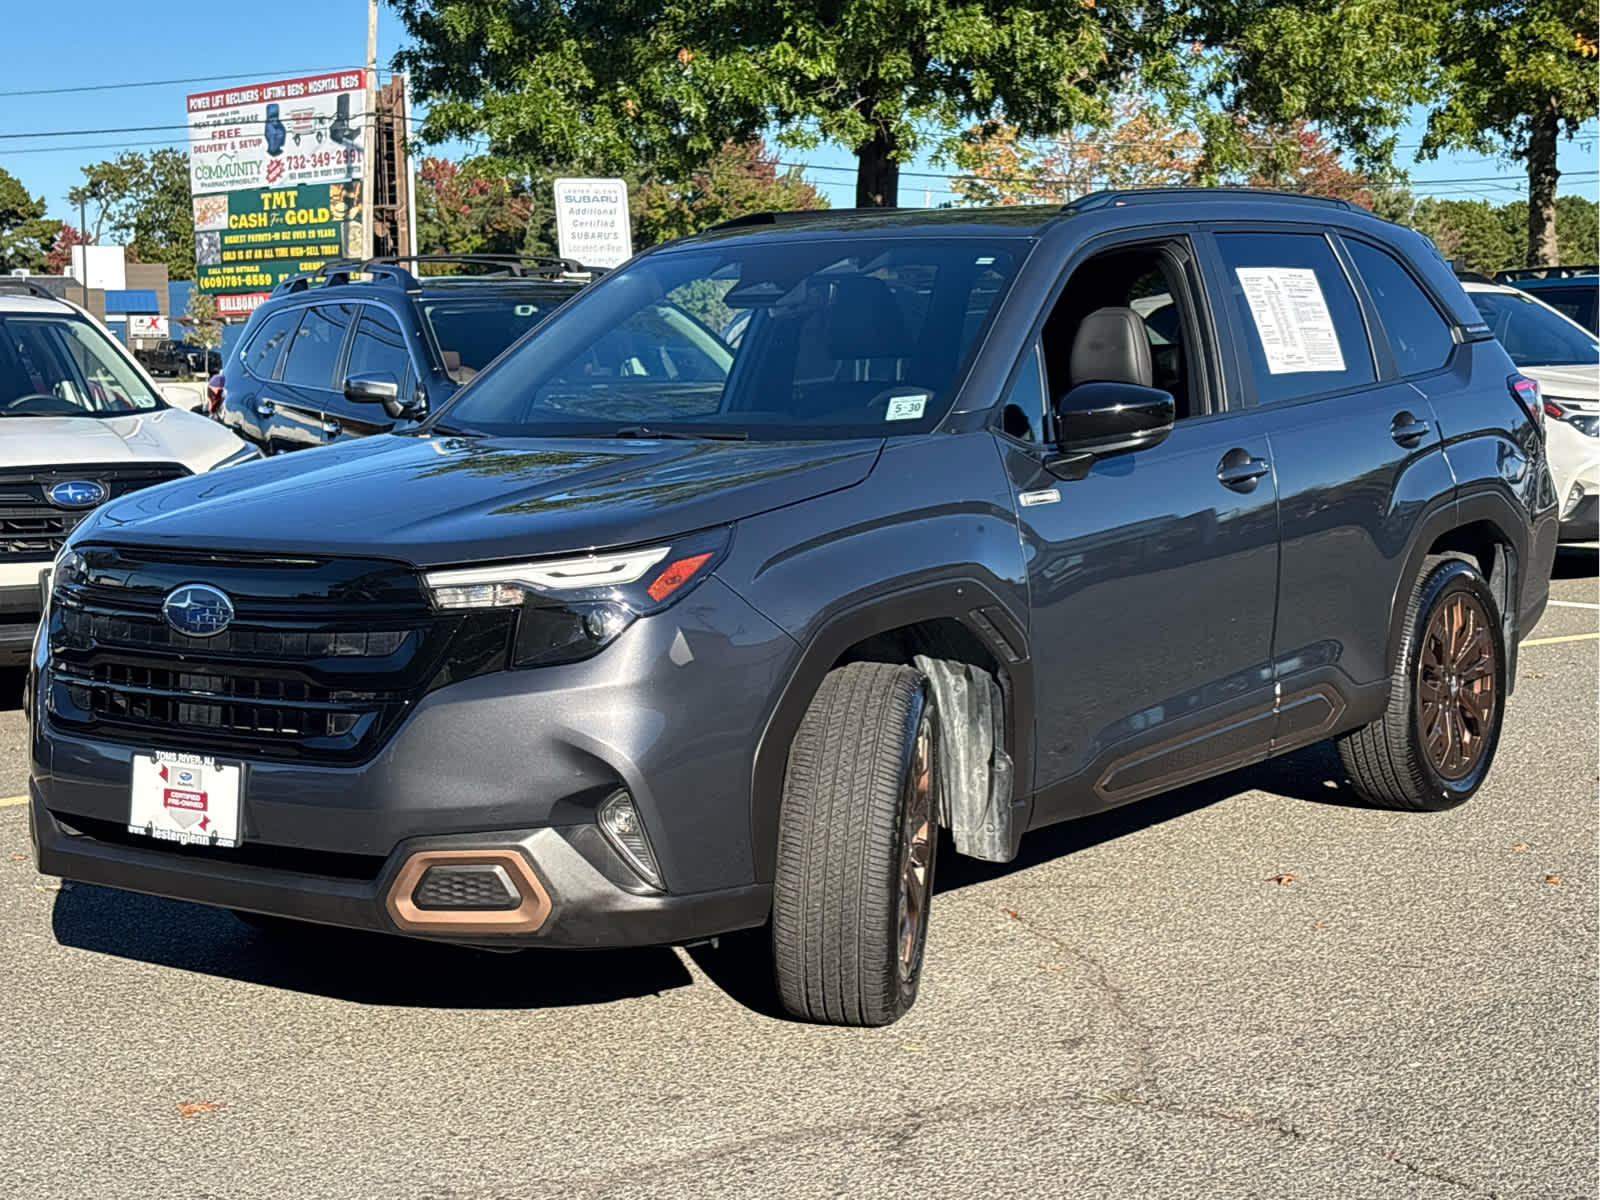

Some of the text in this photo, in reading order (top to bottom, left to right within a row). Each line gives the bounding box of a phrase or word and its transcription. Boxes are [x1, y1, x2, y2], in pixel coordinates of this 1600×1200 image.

[189, 75, 359, 112] POWER LIFT RECLINERS LIFTING BEDS HOSPITAL BEDS
[211, 128, 241, 140] FREE
[193, 143, 228, 153] DELIVERY
[239, 138, 262, 149] SETUP
[286, 148, 362, 170] 732-349-2991
[195, 160, 263, 180] COMMUNITY
[261, 190, 298, 210] TMT
[564, 195, 618, 204] SUBARU
[568, 207, 617, 216] Additional
[229, 212, 268, 229] CASH
[285, 208, 330, 225] GOLD
[572, 219, 615, 228] Certified
[571, 231, 619, 240] SUBARU'S
[200, 274, 272, 289] (609)781-6559
[155, 751, 177, 762] TOMS
[170, 791, 202, 801] CERTIFIED
[167, 798, 204, 809] PRE-OWNED
